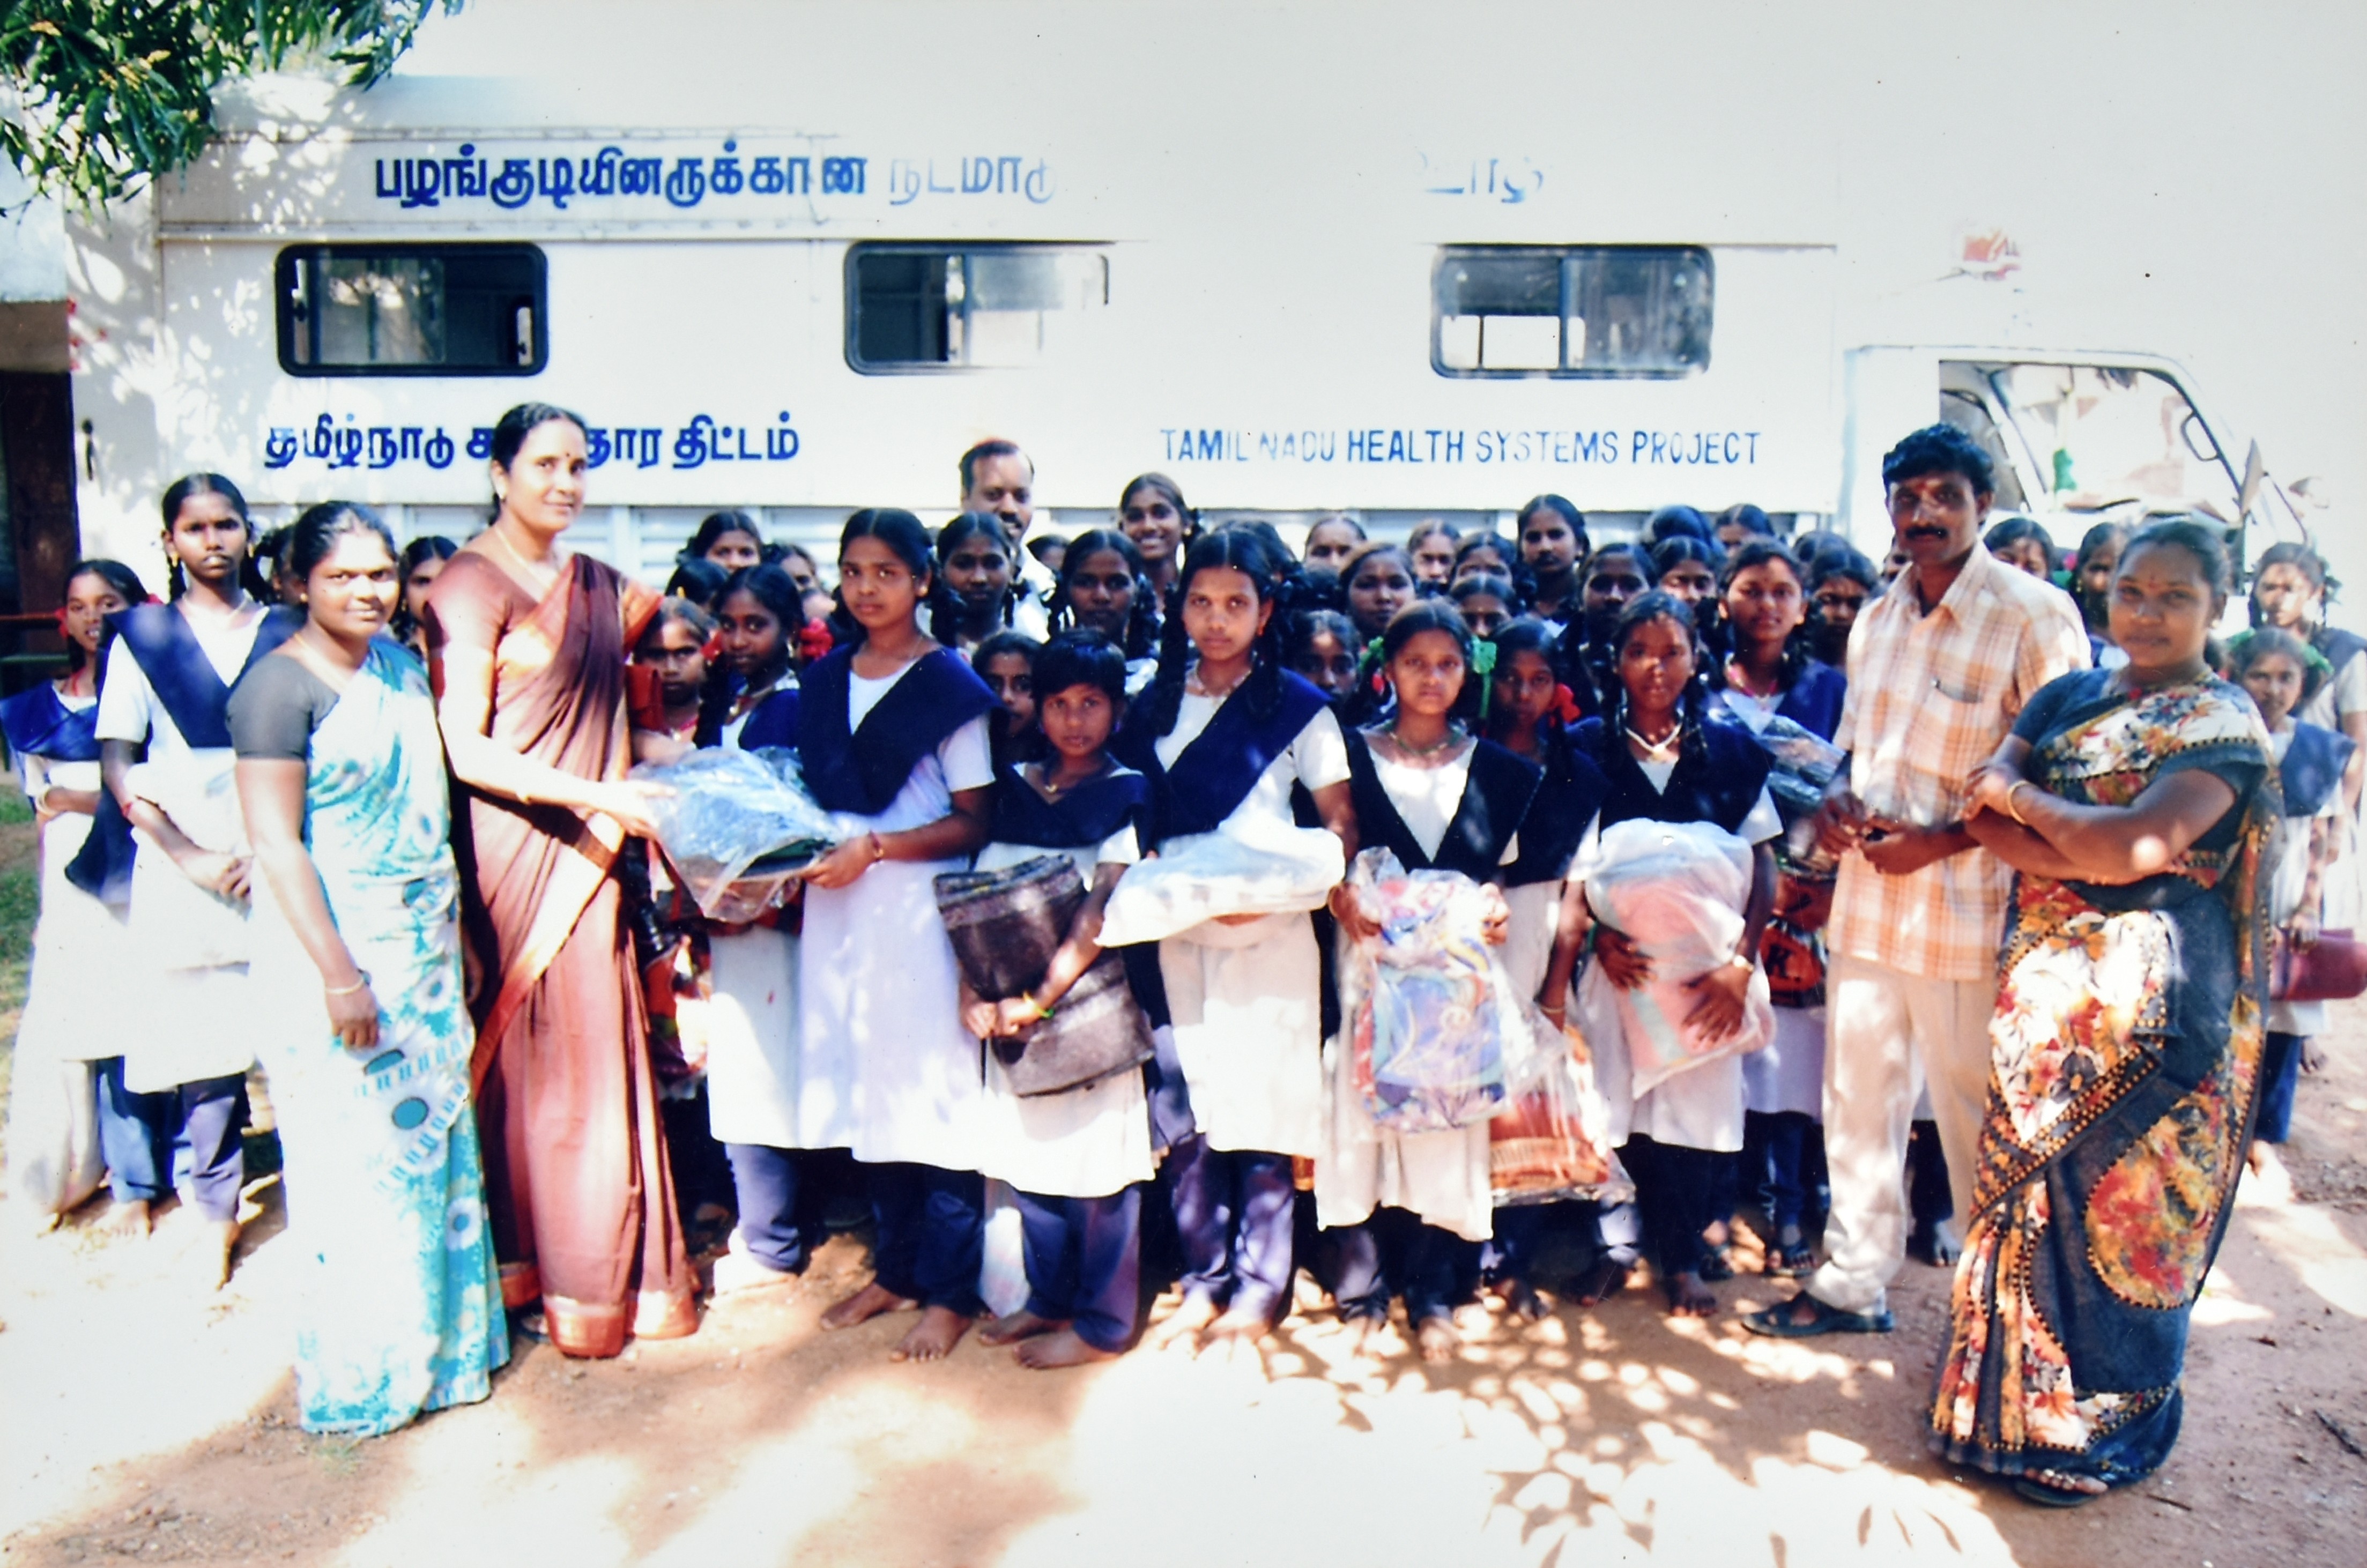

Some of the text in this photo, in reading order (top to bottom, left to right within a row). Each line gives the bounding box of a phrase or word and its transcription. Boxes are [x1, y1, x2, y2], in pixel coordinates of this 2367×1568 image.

[376, 139, 867, 209] பழங்குடியினருக்கான
[264, 413, 454, 469] தமிழ்நாடு
[672, 411, 799, 469] திட்டம்
[1161, 429, 1760, 464] TAMIL NADU HEALTH SYSTEMS PROJECT
